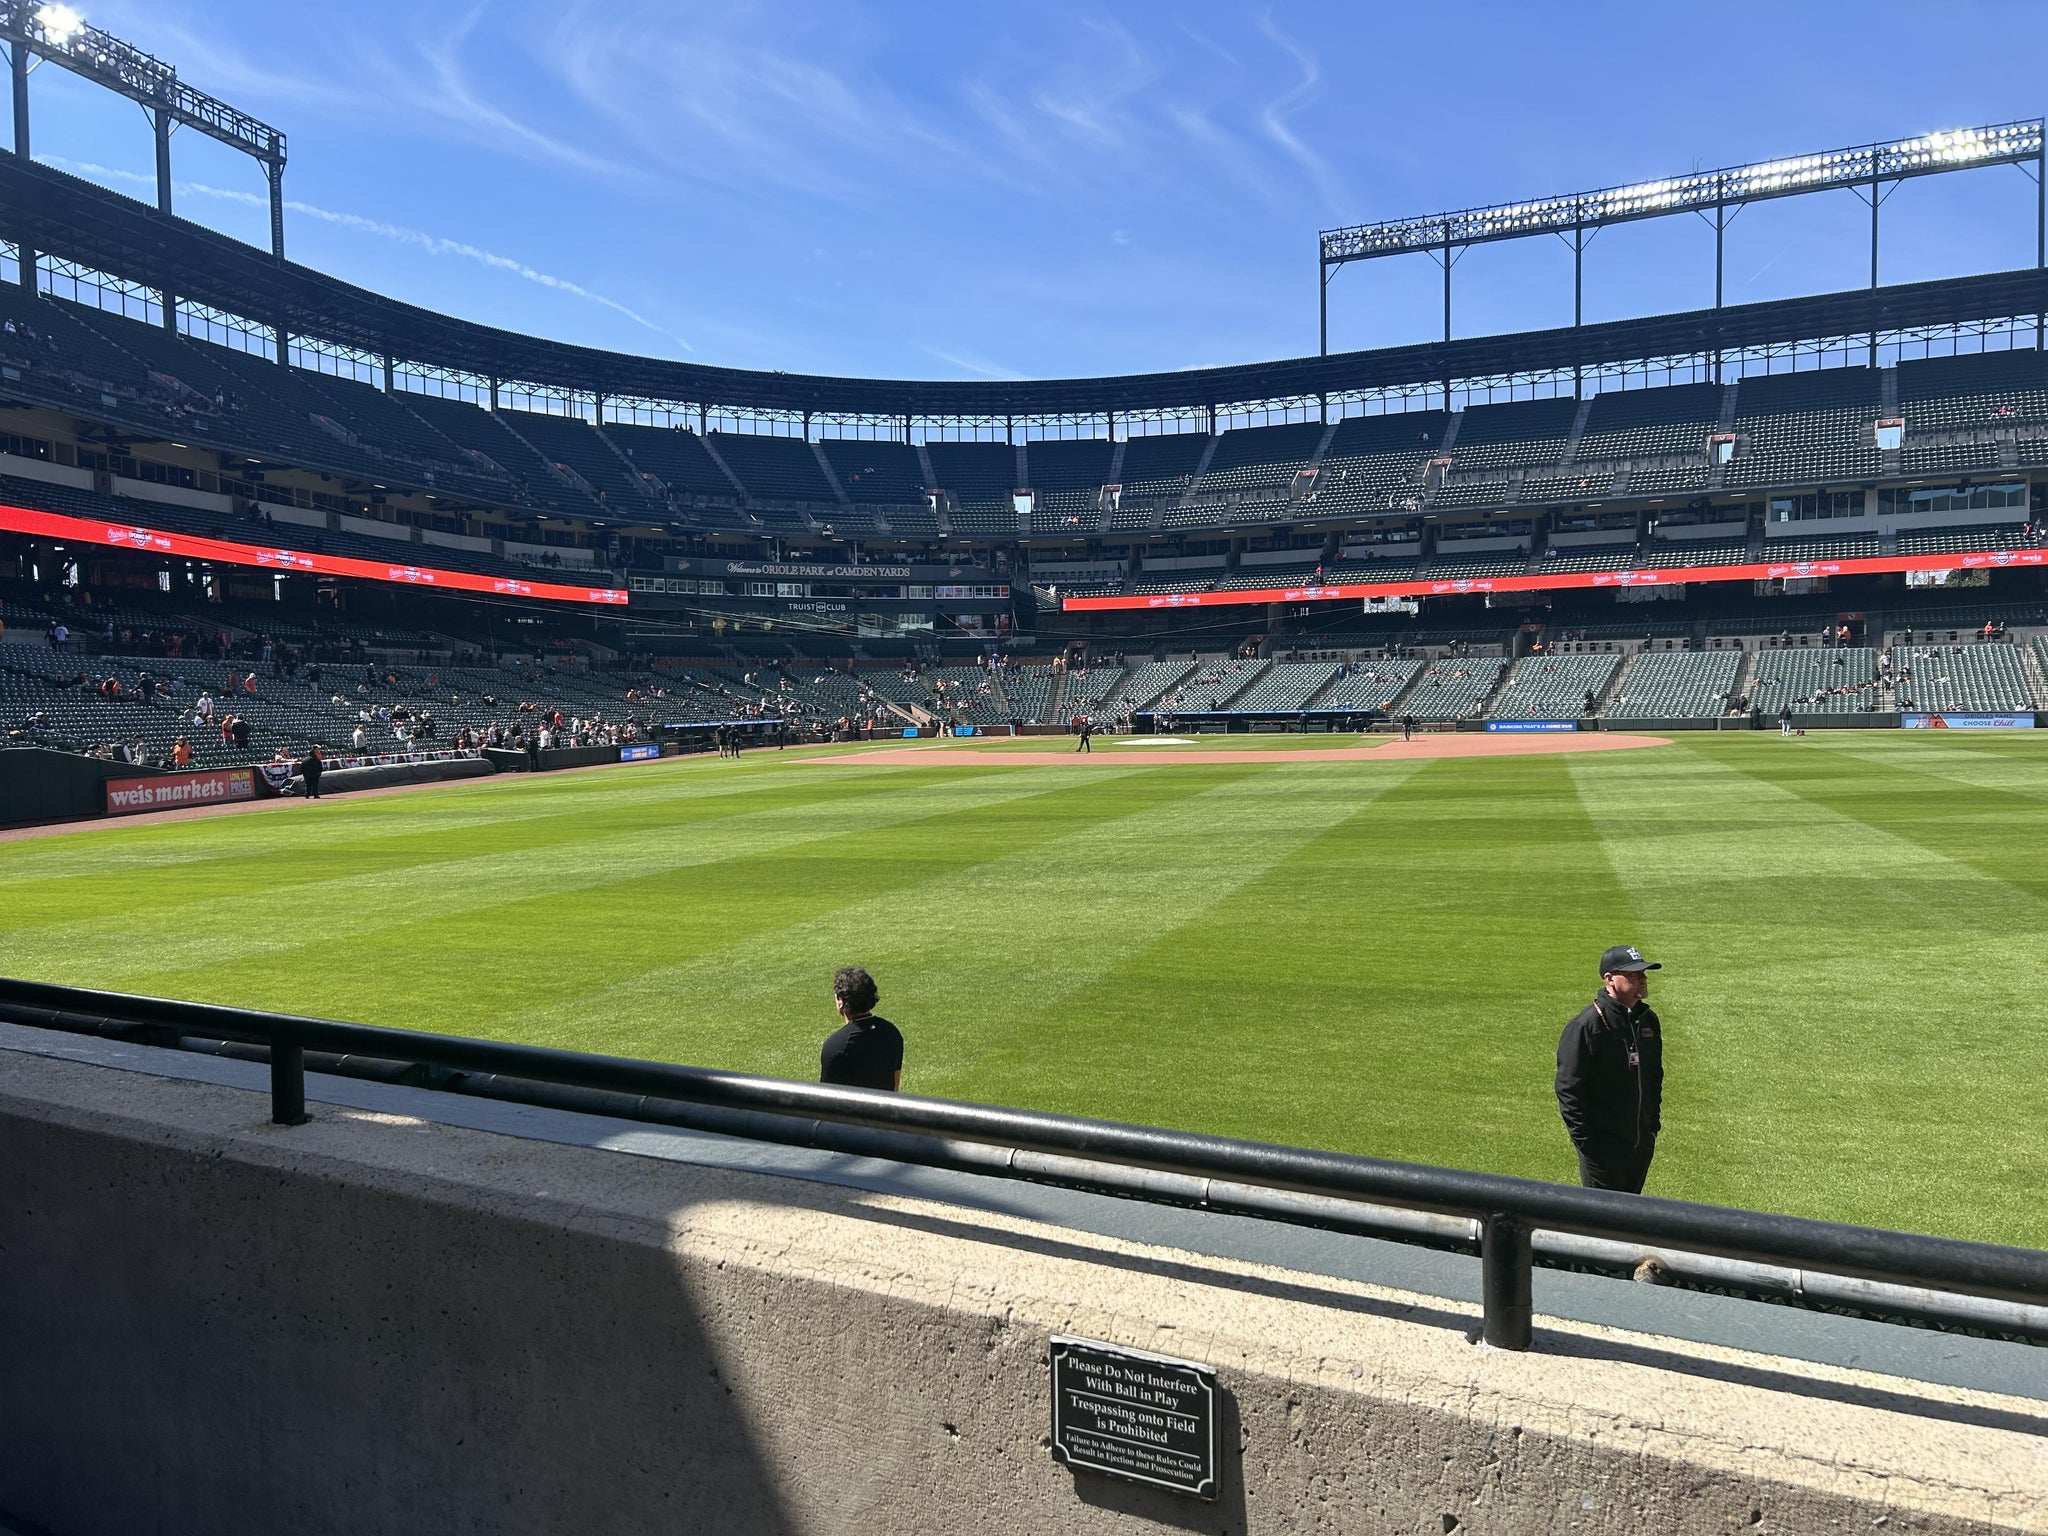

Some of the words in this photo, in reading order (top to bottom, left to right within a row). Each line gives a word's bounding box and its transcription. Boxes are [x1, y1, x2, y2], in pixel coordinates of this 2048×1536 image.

[762, 565, 799, 576] ORIOLE
[800, 566, 825, 576] PARK
[835, 566, 878, 577] CAMDEN
[878, 567, 911, 577] YARDS
[788, 603, 815, 611] TRUIST
[110, 784, 153, 806] weis
[155, 779, 224, 802] markets
[230, 780, 251, 793] PRICES
[1068, 1356, 1102, 1374] Please
[1105, 1364, 1121, 1378] Do
[1124, 1368, 1145, 1385] Not
[1148, 1373, 1198, 1395] Interfere
[1086, 1376, 1112, 1393] With
[1115, 1382, 1137, 1398] Ball
[1140, 1388, 1152, 1401] in
[1155, 1390, 1179, 1410] Play
[1070, 1394, 1136, 1423] Trespassing
[1138, 1412, 1164, 1427] onto
[1166, 1416, 1196, 1434] Field
[1097, 1416, 1106, 1430] is
[1109, 1420, 1168, 1444] Prohibited
[1066, 1432, 1090, 1447] Failure
[1092, 1439, 1099, 1448] to
[1100, 1440, 1126, 1455] Adhere
[1127, 1446, 1135, 1456] to
[1136, 1448, 1155, 1461] these
[1156, 1453, 1177, 1467] Rules
[1178, 1459, 1201, 1472] Could
[1073, 1444, 1096, 1457] Result
[1097, 1449, 1105, 1459] in
[1106, 1451, 1135, 1467] Ejection
[1136, 1458, 1149, 1470] and
[1151, 1462, 1194, 1481] Prosecution
